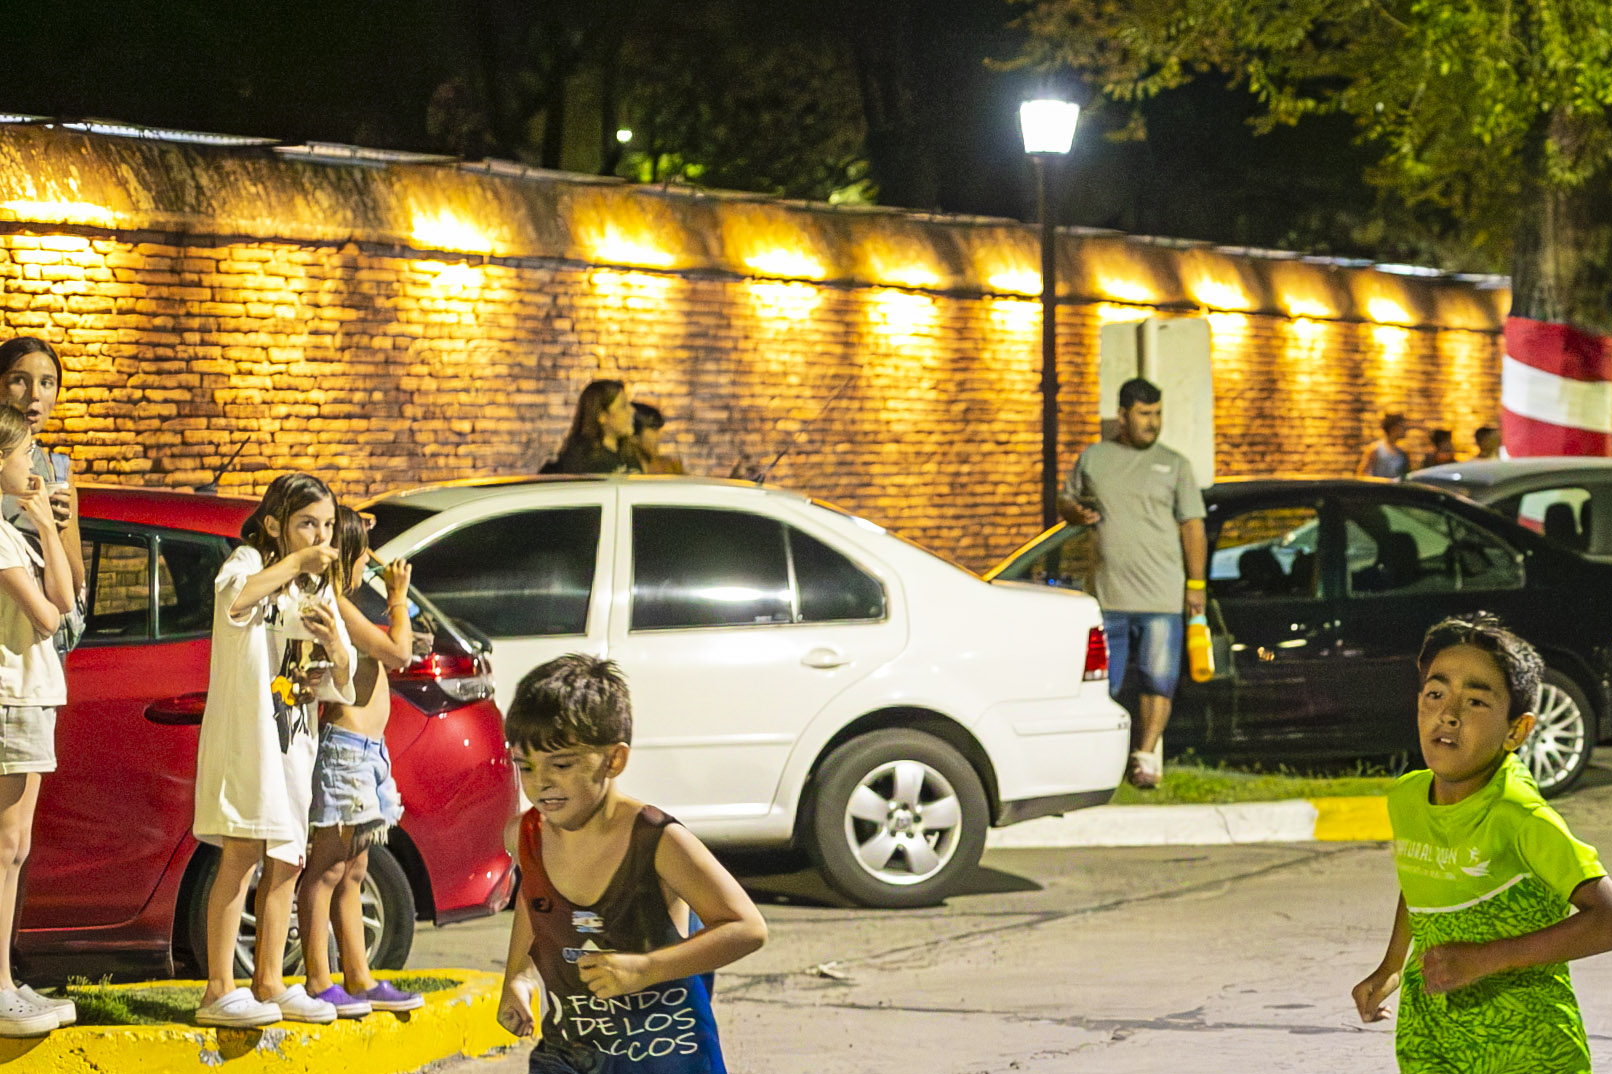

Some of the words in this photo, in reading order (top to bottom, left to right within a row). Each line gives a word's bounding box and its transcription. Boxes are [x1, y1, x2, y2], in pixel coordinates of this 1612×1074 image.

[567, 987, 688, 1015] FONDO
[569, 1017, 619, 1036] DE
[622, 1007, 696, 1036] LOS
